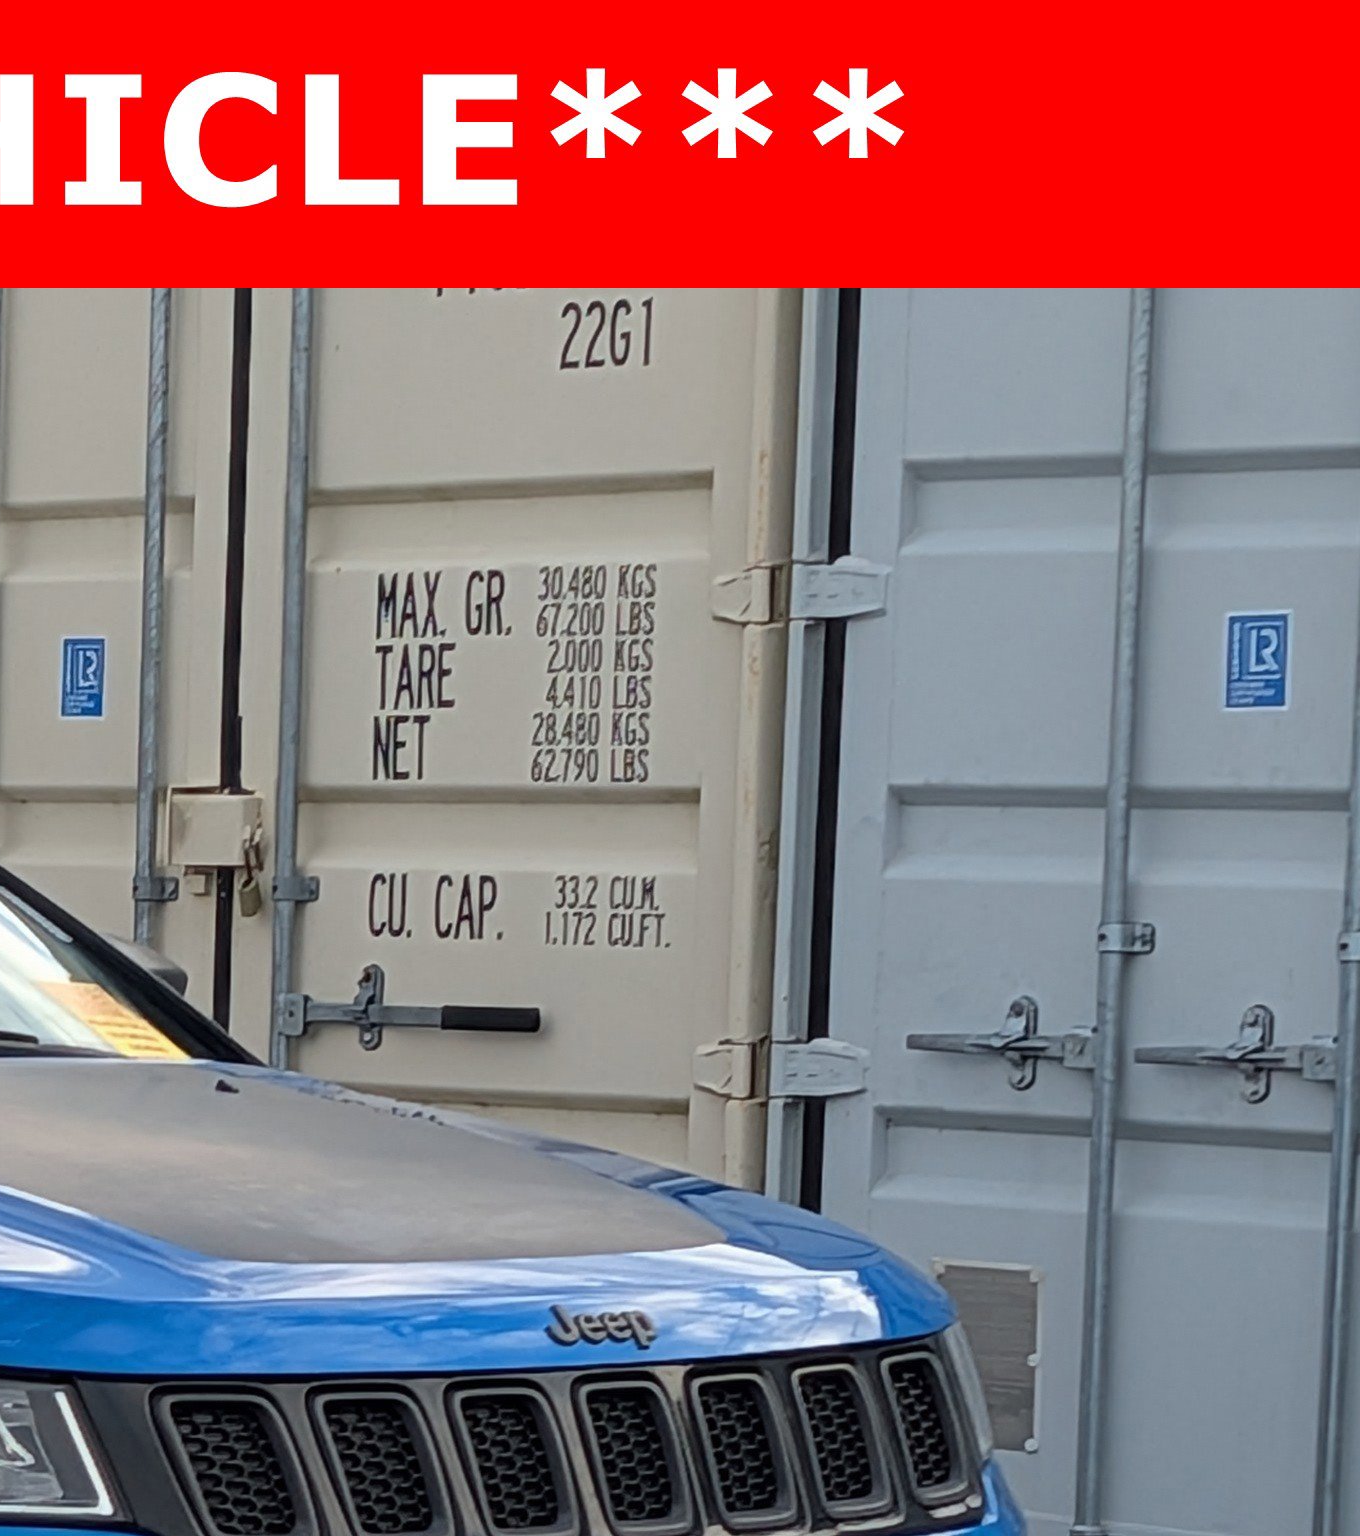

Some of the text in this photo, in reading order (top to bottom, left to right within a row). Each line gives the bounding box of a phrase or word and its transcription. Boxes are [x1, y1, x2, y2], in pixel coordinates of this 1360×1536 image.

[559, 297, 654, 370] 22G1
[618, 563, 657, 599] KGS
[376, 569, 513, 640] MAX. GR.
[616, 601, 656, 637] LBS
[614, 637, 654, 672] KGS
[375, 642, 457, 711] TARE
[612, 674, 652, 710] LBS
[372, 714, 431, 781] NET
[611, 711, 650, 746] KGS
[610, 748, 650, 783] LBS
[369, 872, 503, 940] CU. CAP.
[544, 1304, 657, 1350] Jeep
